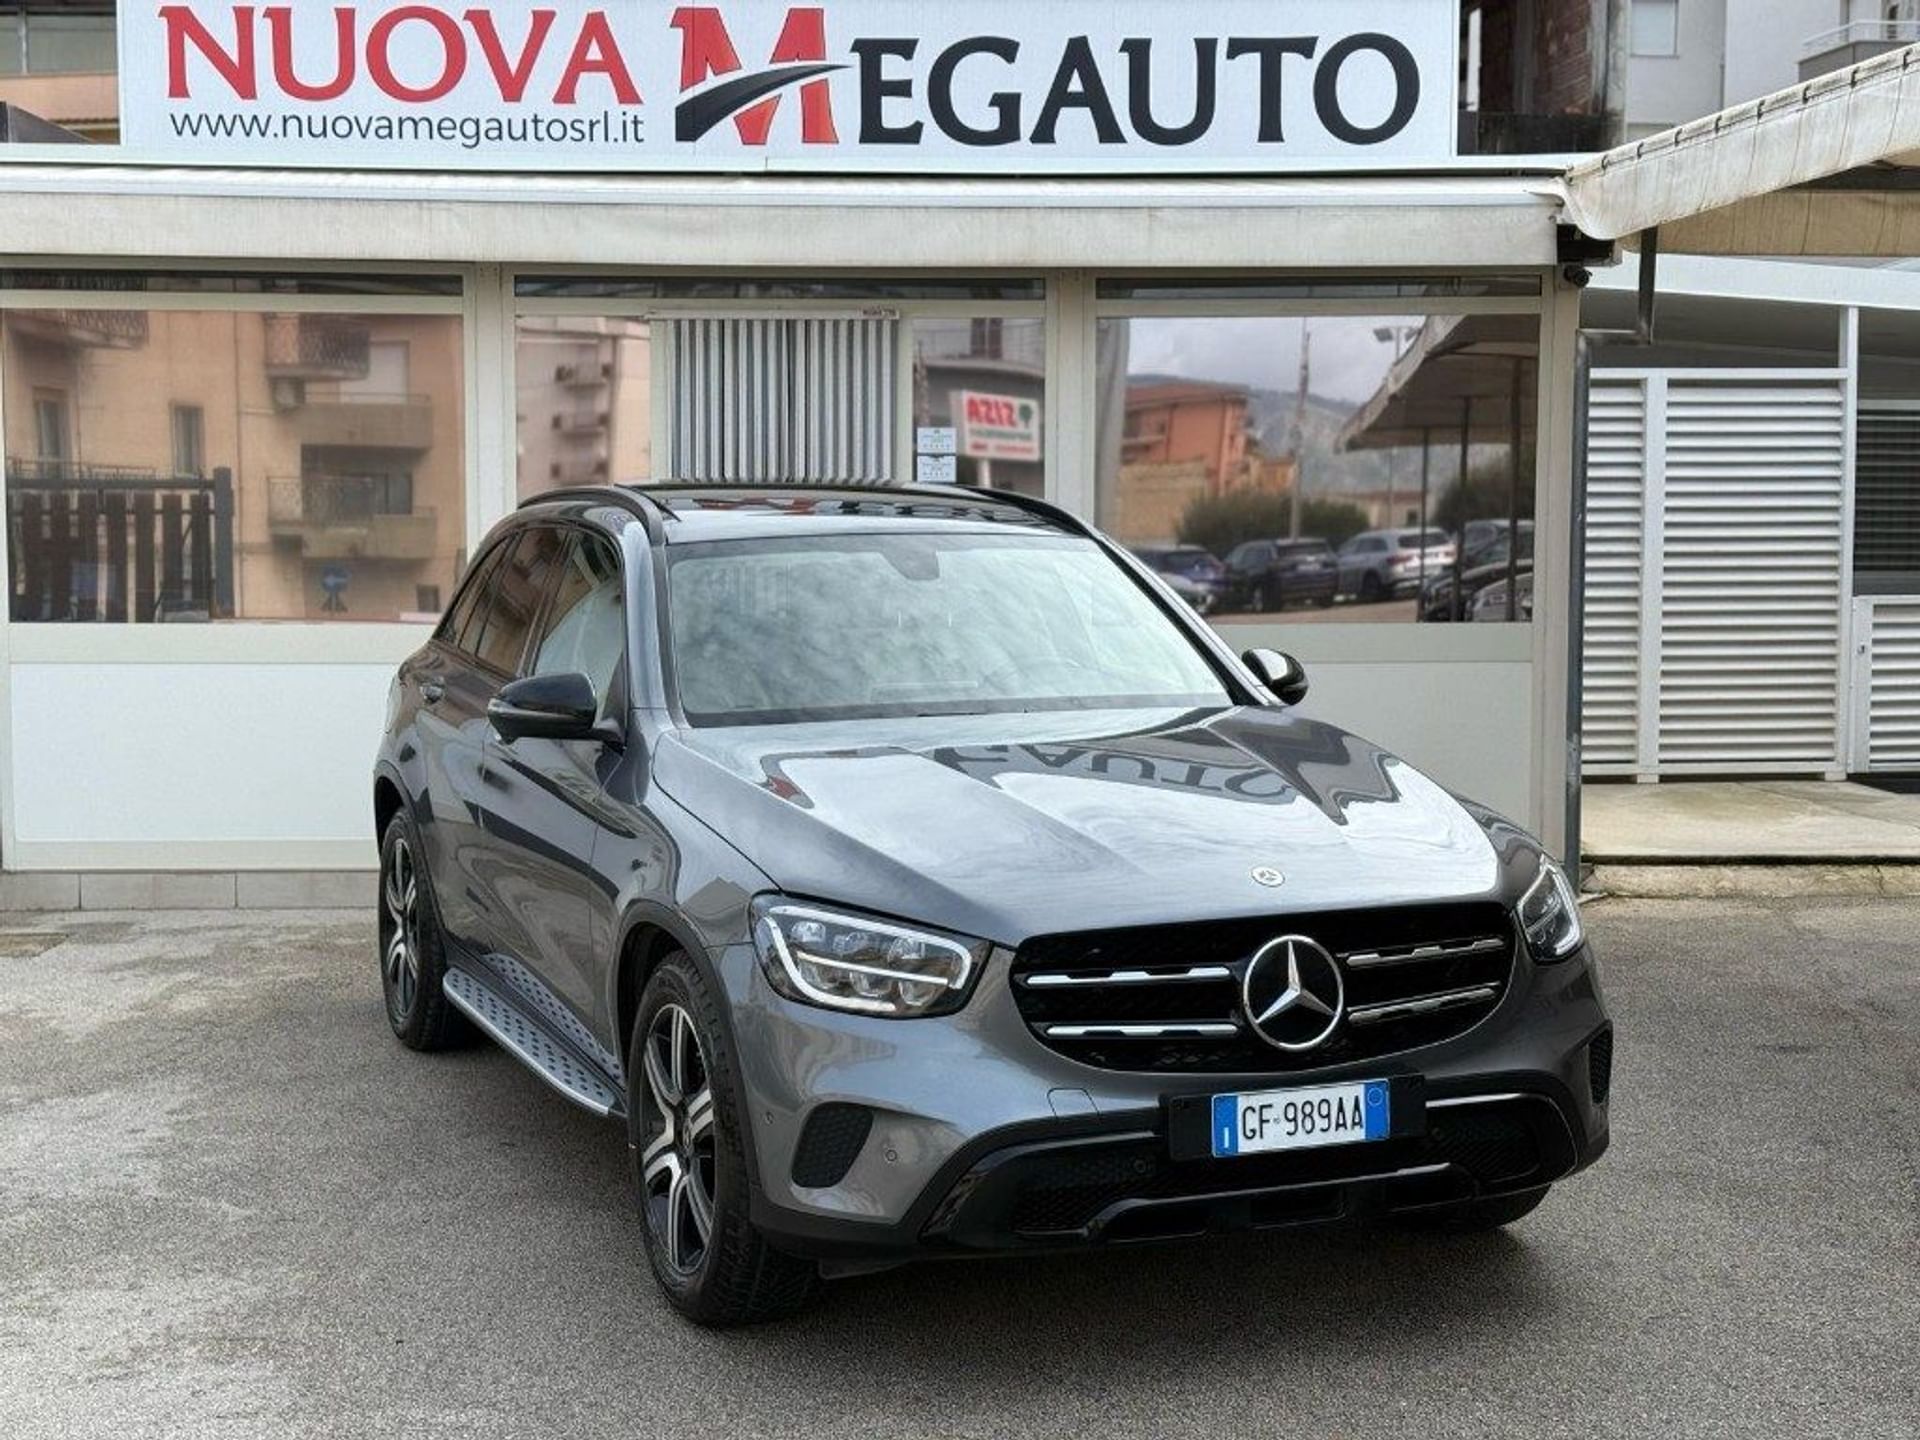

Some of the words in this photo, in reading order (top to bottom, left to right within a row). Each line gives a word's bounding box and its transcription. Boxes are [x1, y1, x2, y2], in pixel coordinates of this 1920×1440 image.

[159, 6, 644, 104] NUOVA
[670, 7, 1420, 145] MEGAUTO
[170, 110, 644, 149] www.nuovamegautosrl.it
[1283, 1094, 1363, 1136] 989AA
